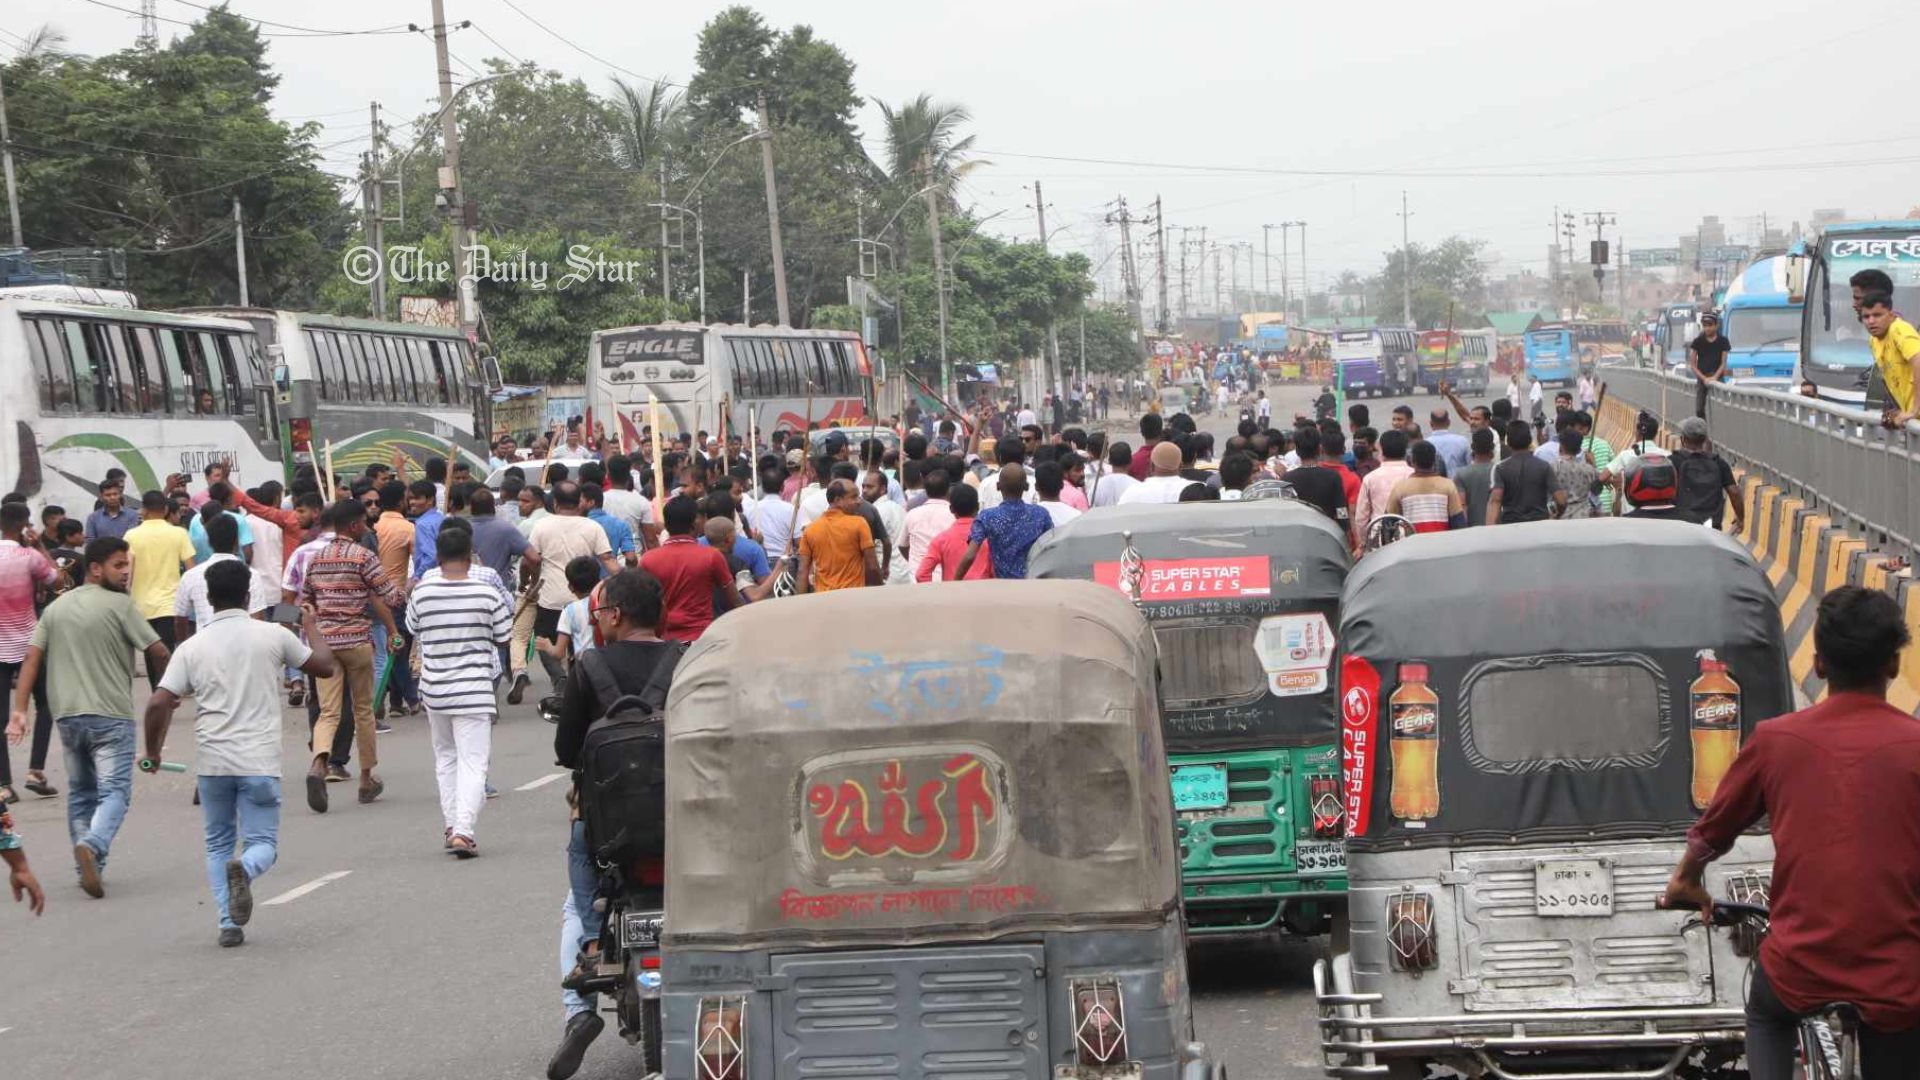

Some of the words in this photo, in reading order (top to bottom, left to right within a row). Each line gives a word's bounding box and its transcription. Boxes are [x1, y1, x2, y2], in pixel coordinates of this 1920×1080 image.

[1151, 567, 1200, 580] SUPER
[1202, 566, 1241, 579] STAR
[1151, 580, 1241, 593] CABLES
[1694, 702, 1738, 720] GEAR
[1394, 712, 1436, 731] GEAR
[1351, 730, 1367, 792] SUPER
